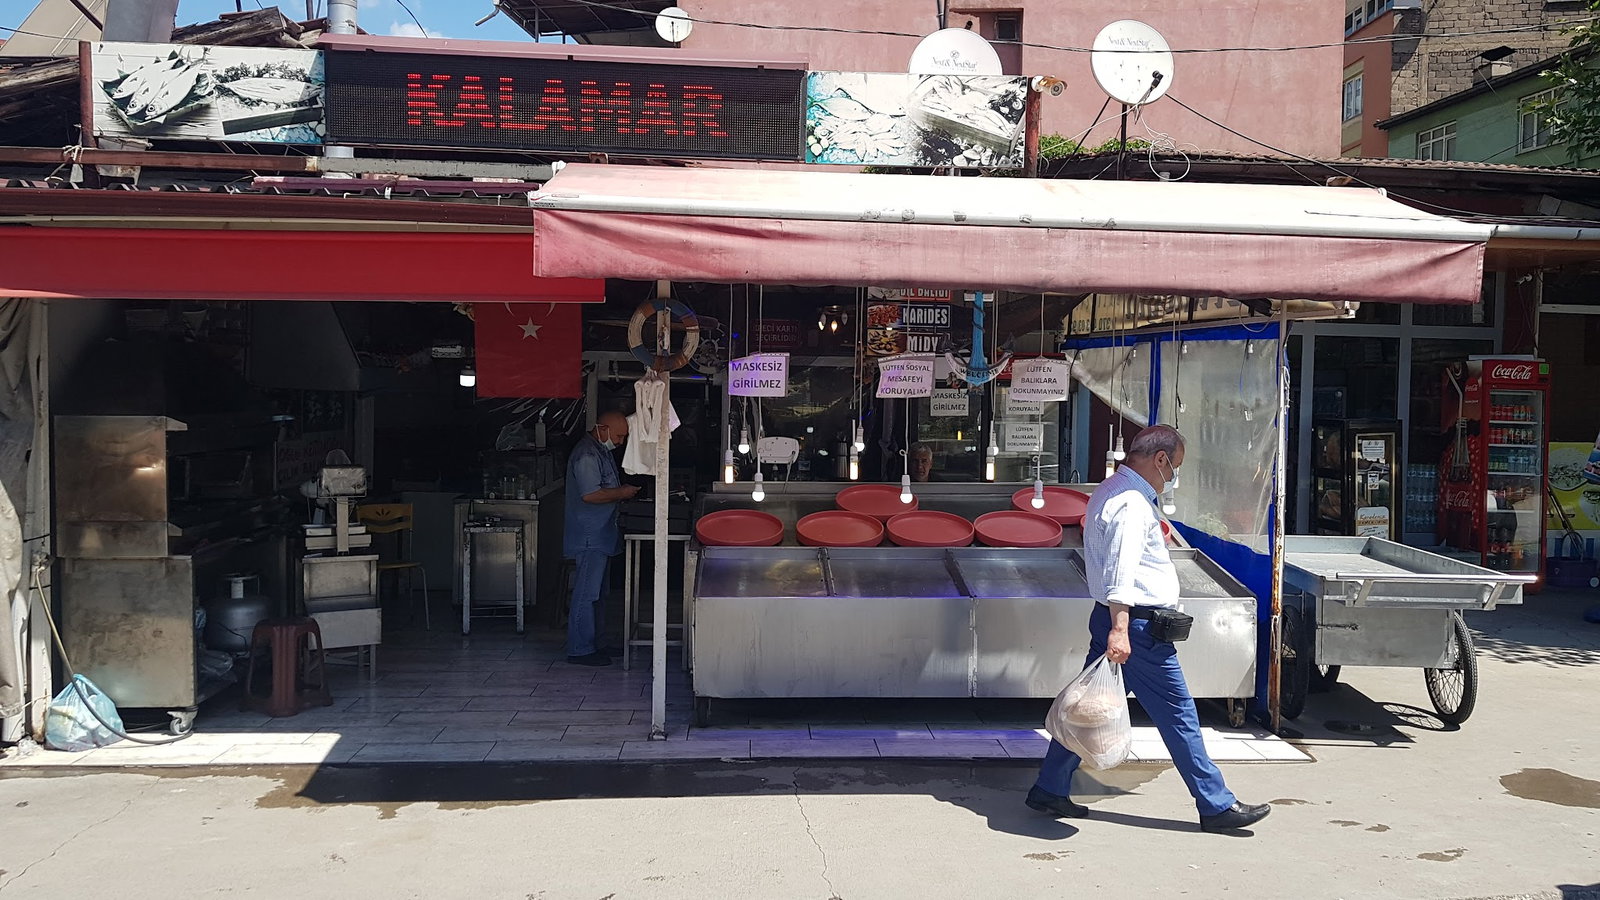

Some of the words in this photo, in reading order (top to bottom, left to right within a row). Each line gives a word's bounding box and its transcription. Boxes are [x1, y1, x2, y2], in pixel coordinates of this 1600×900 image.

[407, 73, 728, 137] KALAMAR
[902, 308, 948, 324] KARİDES
[907, 335, 944, 352] MİDY
[731, 361, 783, 371] MASKESİZ
[1492, 364, 1533, 380] Coca-Cola
[732, 378, 781, 389] GİRİLMEZ
[887, 375, 923, 383] MESAFEYİ
